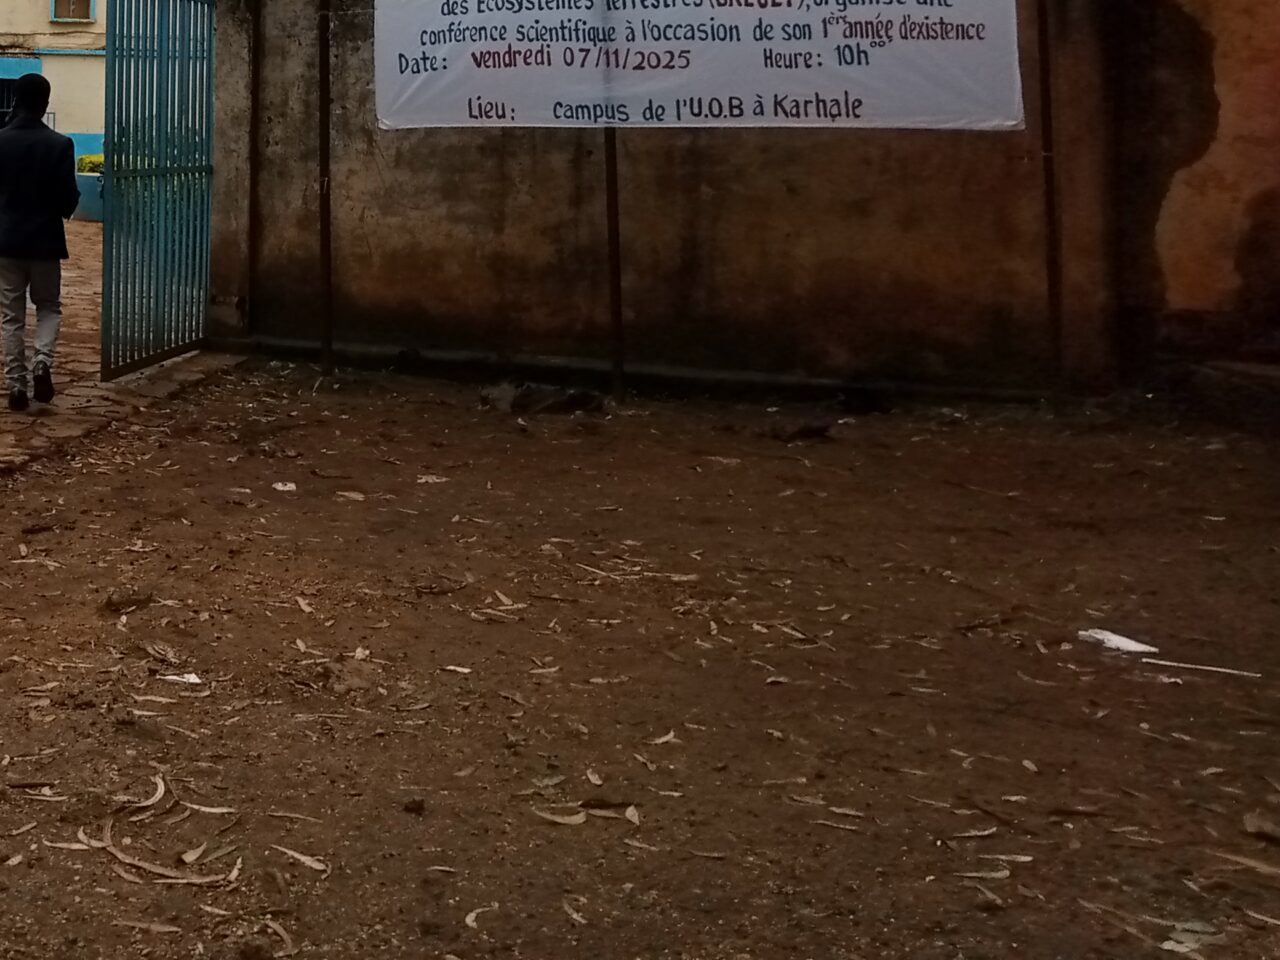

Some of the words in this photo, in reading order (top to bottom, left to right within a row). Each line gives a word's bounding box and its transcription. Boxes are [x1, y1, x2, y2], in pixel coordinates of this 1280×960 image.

[420, 20, 507, 46] conférence
[516, 19, 616, 50] scientifique
[625, 20, 636, 42] à
[642, 17, 741, 43] l'occasion
[753, 17, 774, 41] de
[781, 20, 812, 40] son
[842, 13, 894, 41] année
[899, 14, 986, 41] d'existence
[398, 52, 448, 75] Date:
[471, 43, 552, 70] vendredi
[563, 46, 691, 71] 07/11/2025
[763, 47, 823, 70] Heure:
[468, 95, 515, 121] Lieu:
[642, 98, 665, 121] de
[753, 94, 765, 116] à
[774, 90, 863, 122] Karhale
